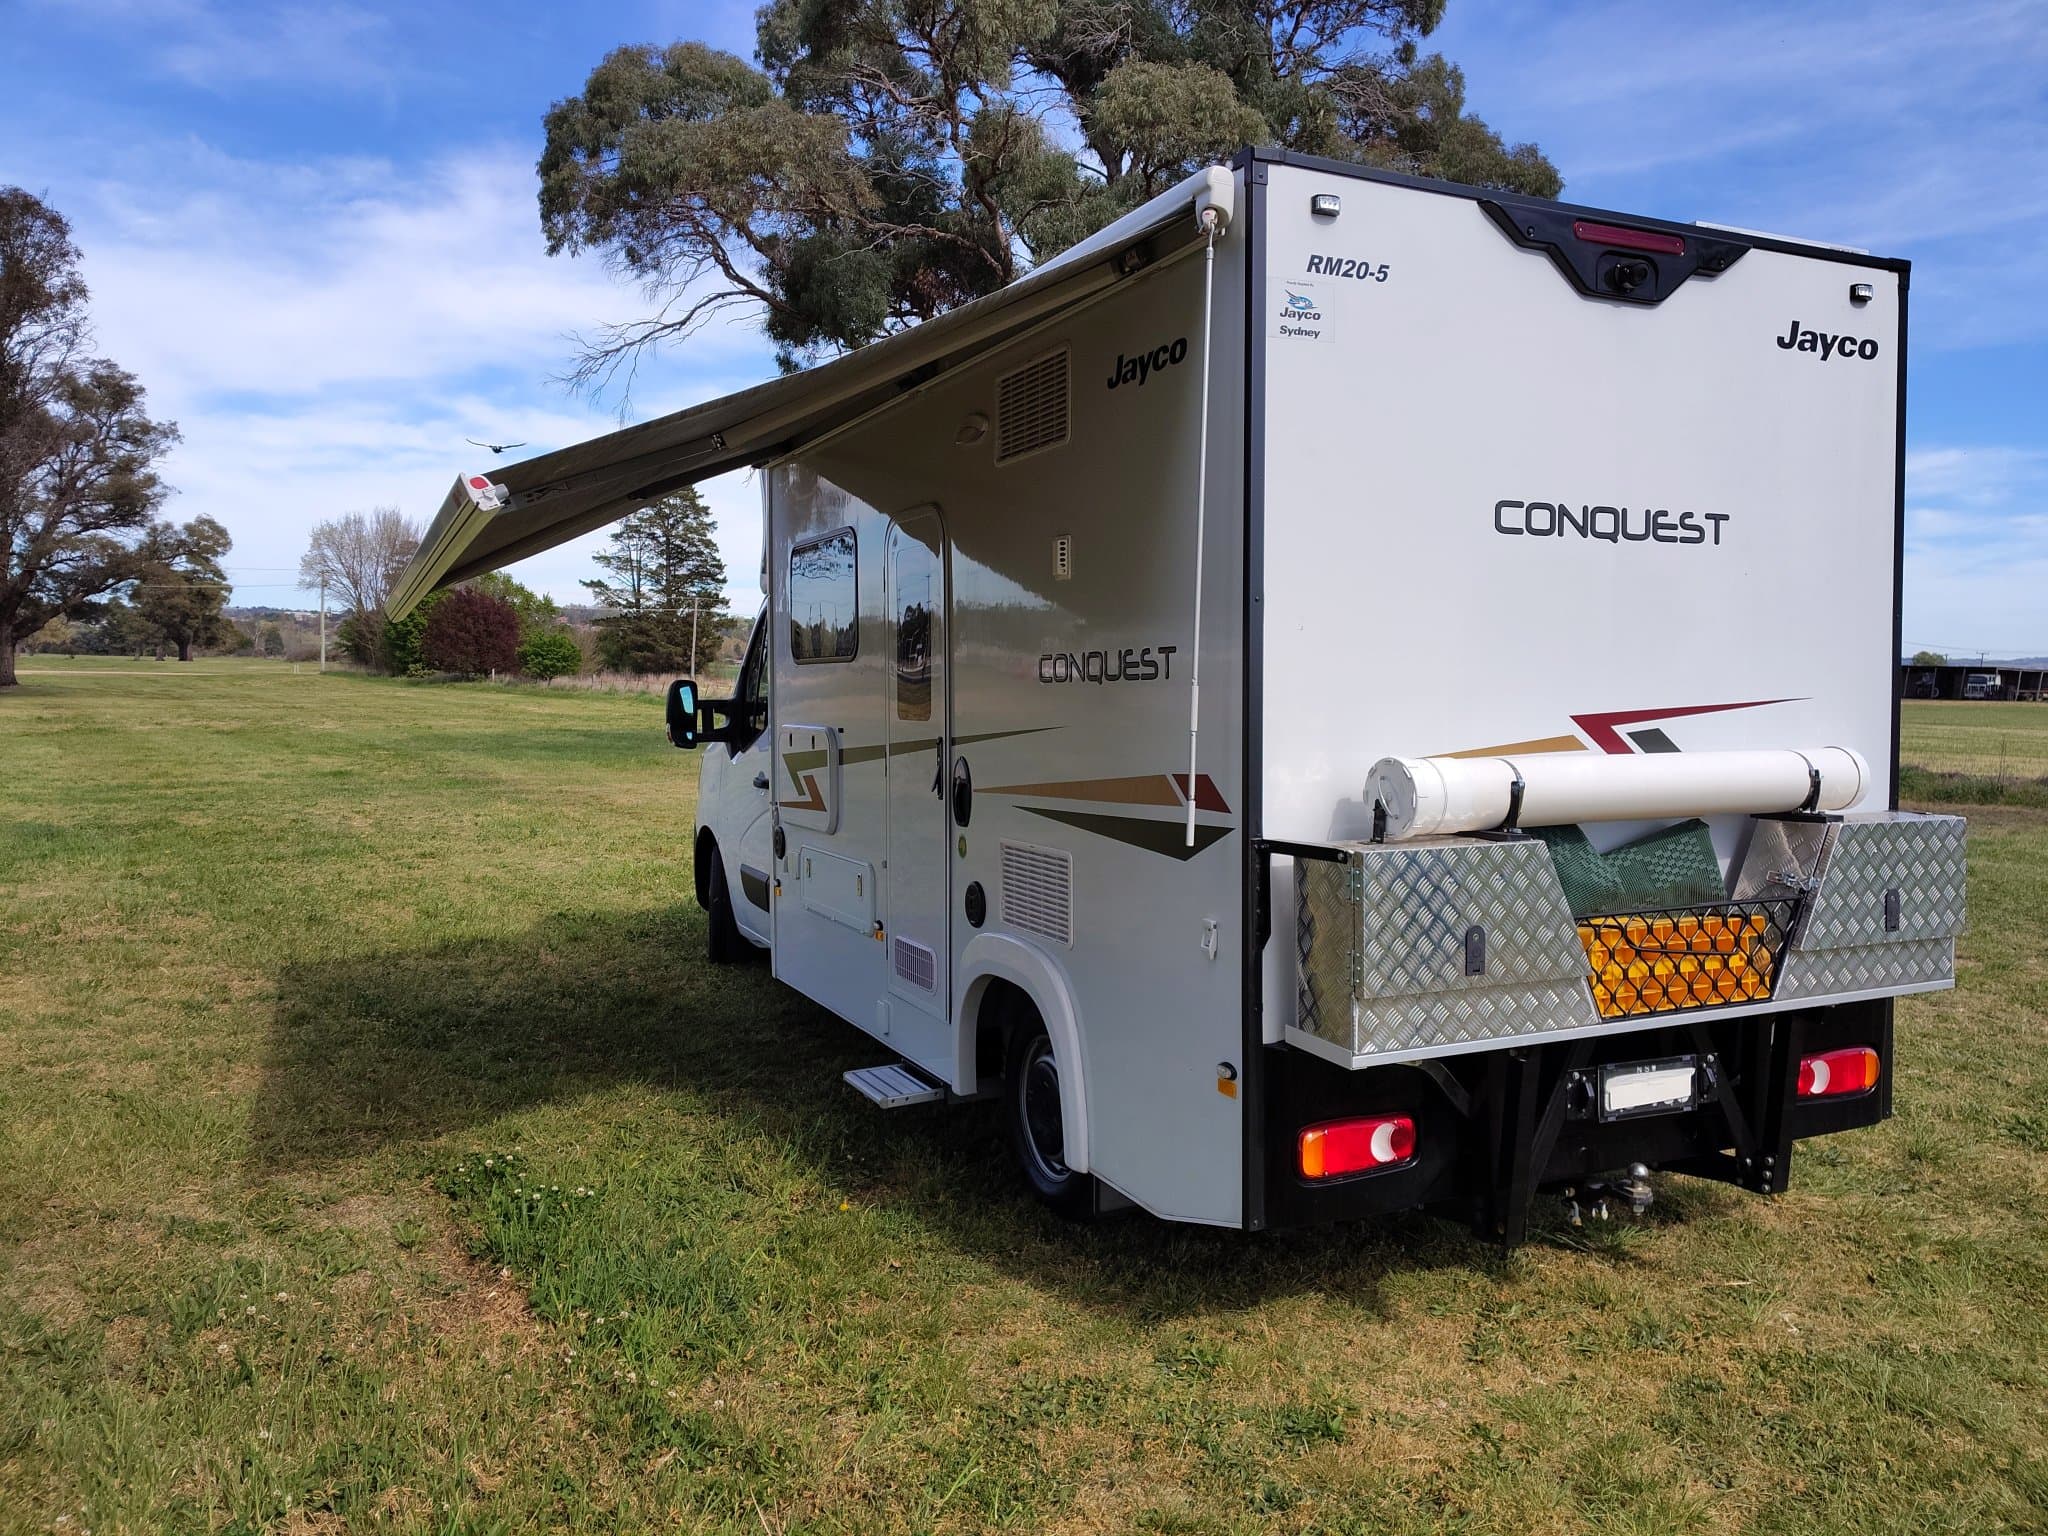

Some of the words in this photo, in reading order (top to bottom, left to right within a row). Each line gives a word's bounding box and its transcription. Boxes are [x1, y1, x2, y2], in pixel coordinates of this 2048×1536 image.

[1306, 254, 1390, 283] RM20-5
[1280, 307, 1321, 321] Jayco
[1280, 325, 1320, 339] Sydney
[1776, 320, 1879, 361] Jayco
[1107, 337, 1187, 389] Jayco
[1494, 499, 1730, 545] CONQUEST
[1038, 646, 1177, 685] CONQUEST
